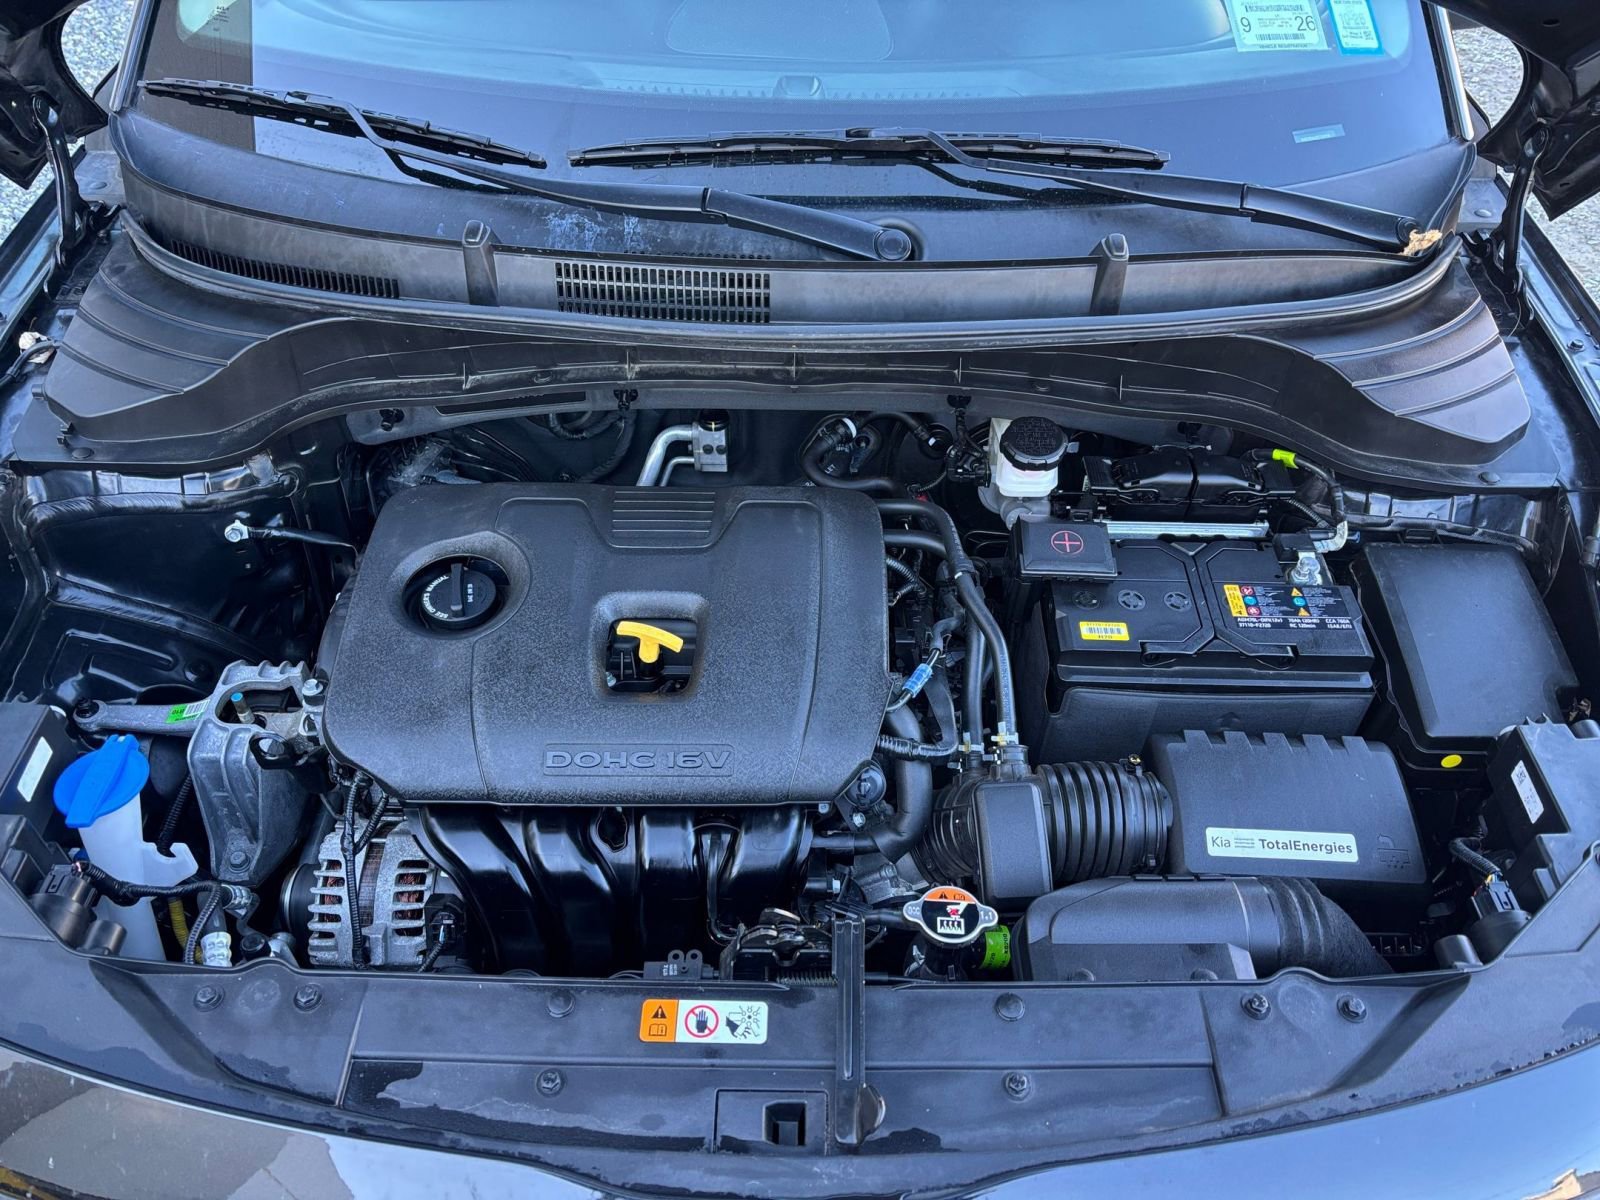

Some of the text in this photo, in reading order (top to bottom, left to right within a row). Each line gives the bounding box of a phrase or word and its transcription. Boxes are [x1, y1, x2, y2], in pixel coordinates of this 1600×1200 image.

[1240, 17, 1252, 33] 9
[1294, 15, 1316, 32] 26
[425, 575, 450, 592] MANUAL
[545, 751, 731, 769] DOHC 16V
[1211, 836, 1353, 854] Kia TotalEnergies
